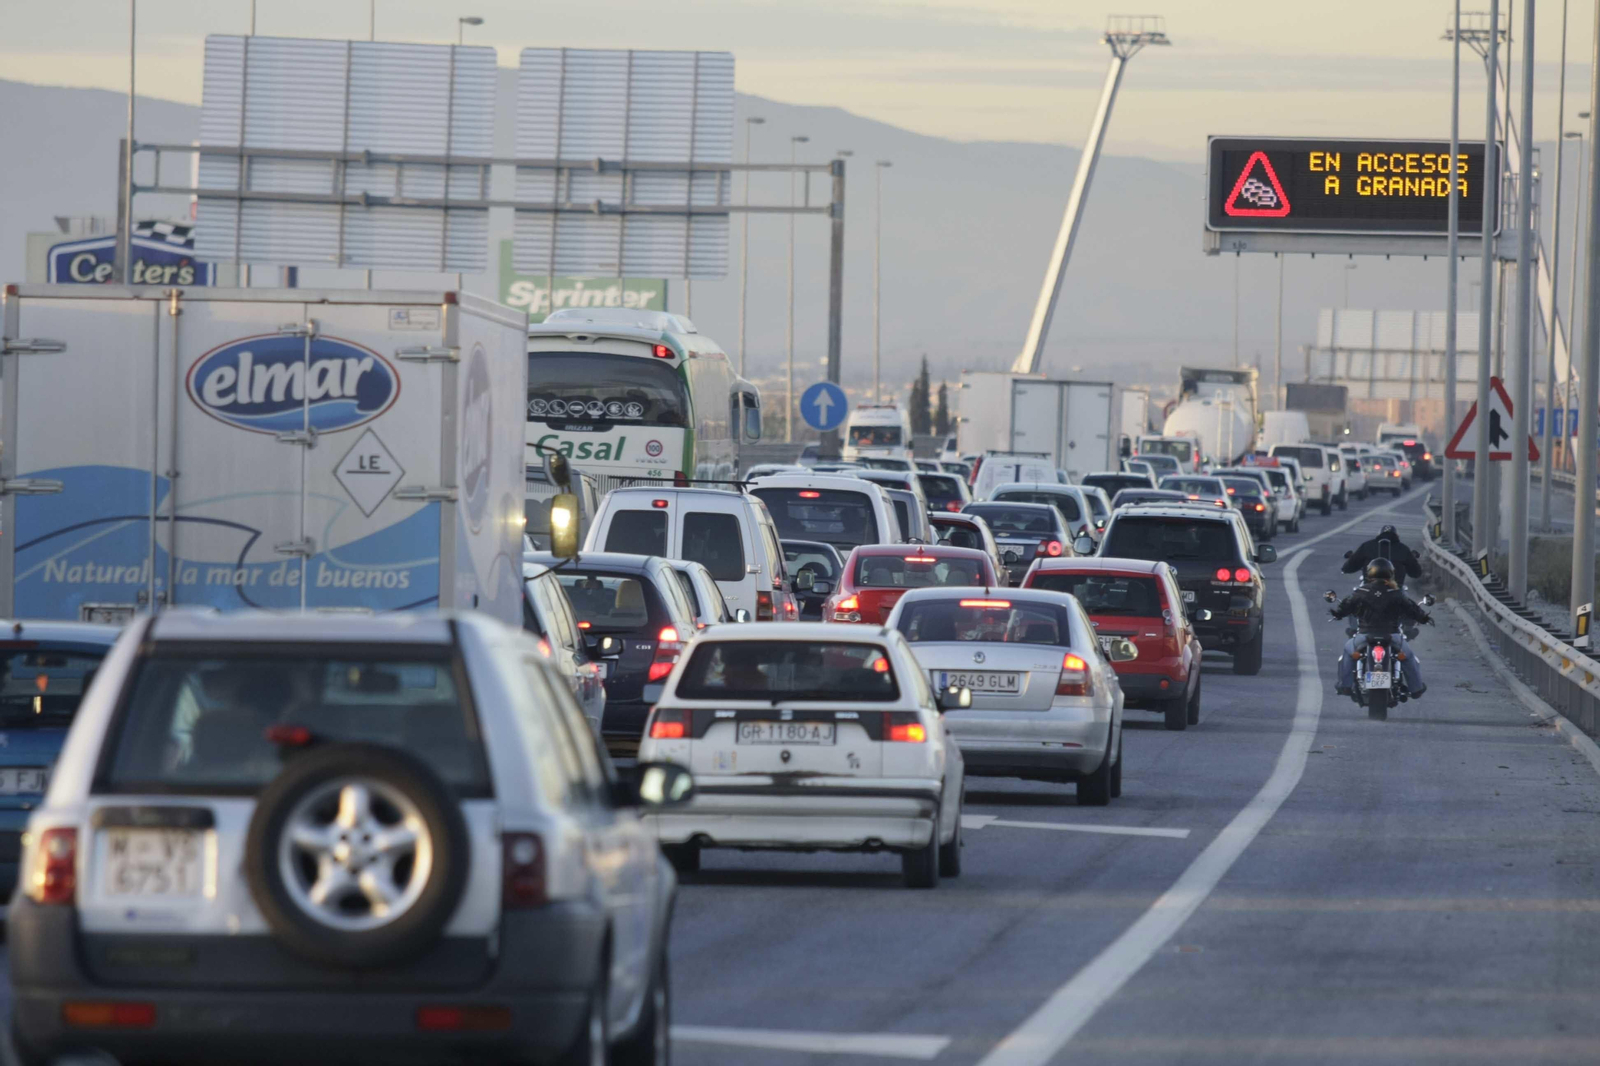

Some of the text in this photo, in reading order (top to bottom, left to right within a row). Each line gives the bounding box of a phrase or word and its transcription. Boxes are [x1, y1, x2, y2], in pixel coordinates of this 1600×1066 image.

[1309, 152, 1468, 174] EN ACCESOS
[1324, 175, 1468, 197] A GRANADA
[70, 253, 195, 285] Ceter's
[506, 281, 656, 314] Sprinter
[202, 352, 374, 406] elmar
[535, 434, 626, 461] Casal
[359, 455, 380, 470] LE
[175, 560, 198, 585] la
[206, 567, 263, 586] mar
[268, 562, 301, 587] de
[316, 562, 410, 589] buenos
[950, 674, 1015, 688] 2649 GLM
